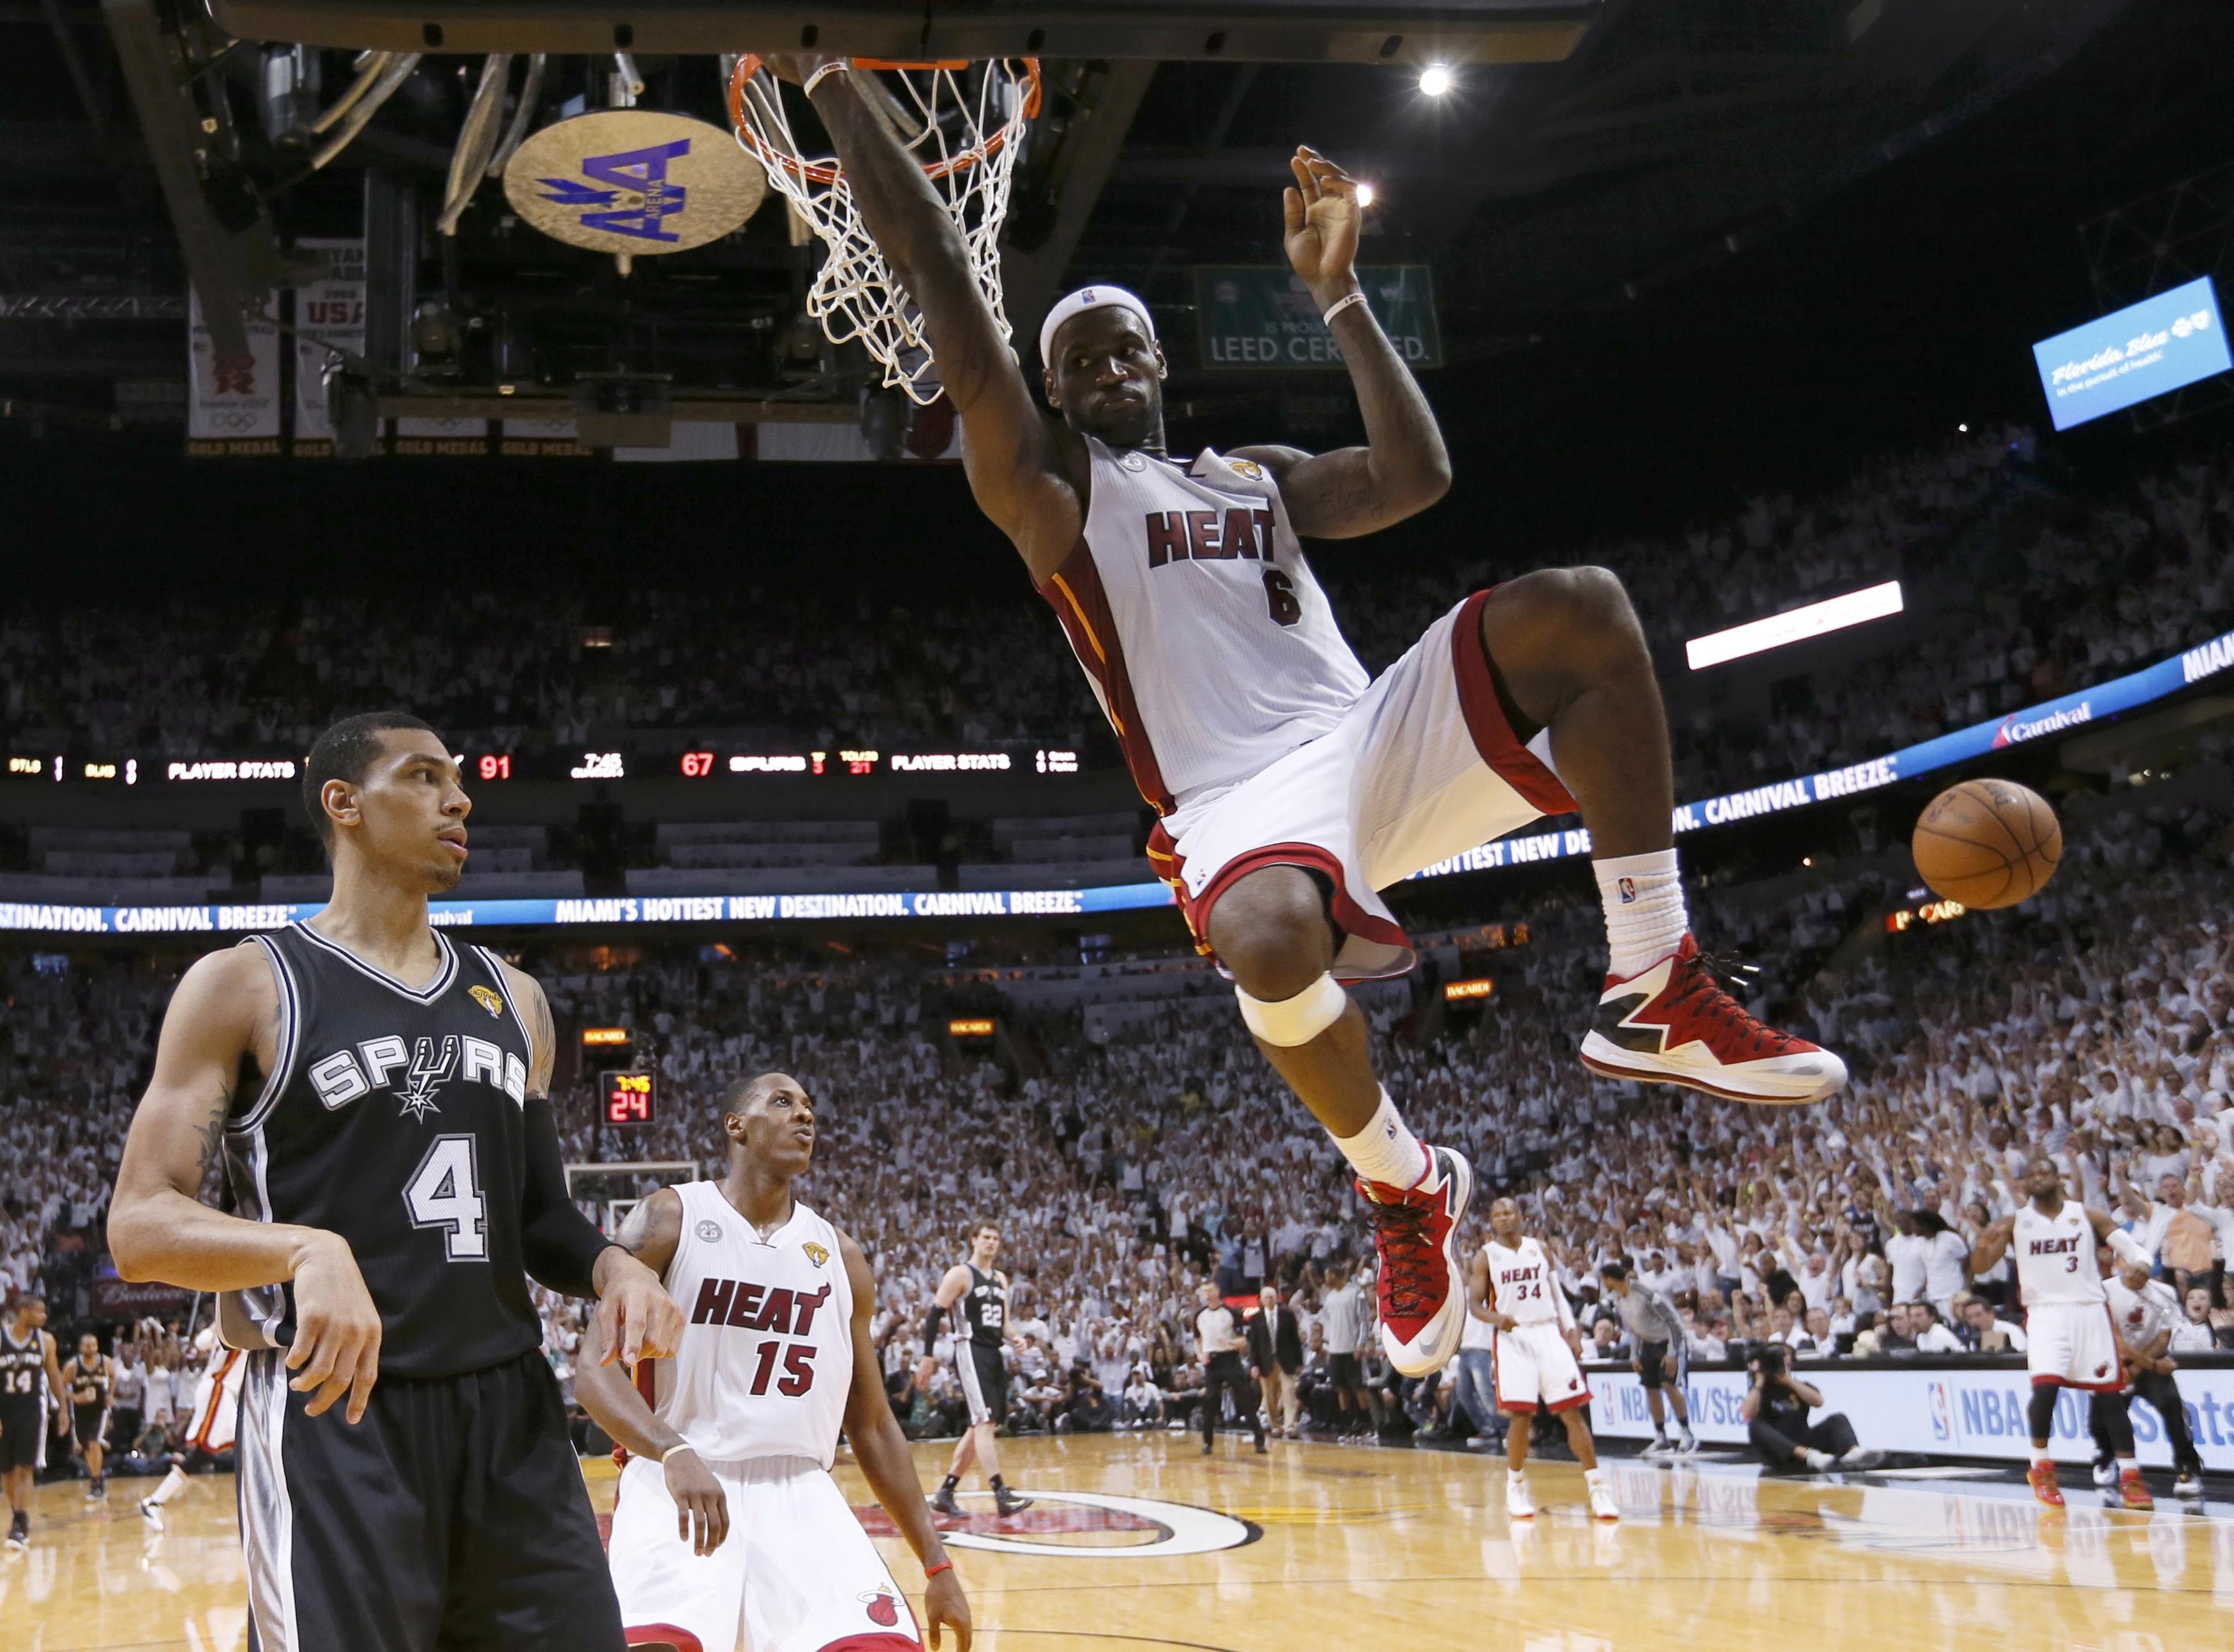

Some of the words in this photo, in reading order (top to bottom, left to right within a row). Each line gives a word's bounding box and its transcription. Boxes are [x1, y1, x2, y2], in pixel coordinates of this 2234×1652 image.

[644, 179, 664, 220] ARENA
[1211, 336, 1278, 361] LEED
[1287, 336, 1430, 361] CERED.
[2052, 347, 2124, 385] Florida
[2125, 331, 2168, 357] Blue
[1146, 498, 1275, 568] HEAT
[1261, 569, 1302, 627] 6
[2011, 701, 2092, 742] Carnival
[169, 762, 237, 779] PLAYER
[239, 762, 296, 779] STATS
[481, 756, 509, 779] 91
[682, 753, 714, 776] 67
[891, 755, 956, 770] PLAYER
[957, 754, 1010, 769] STATS
[1705, 779, 1811, 824] CARNIVAL
[1510, 834, 1559, 864] NEW
[115, 907, 213, 932] CARNIVAL
[428, 909, 473, 926] rnival
[555, 899, 638, 922] MIAMI'S
[643, 897, 725, 921] HOTTEST
[729, 896, 776, 919] NEW
[780, 894, 909, 918] DESTINATION.
[914, 892, 1006, 915] CARNIVAL
[308, 1035, 529, 1114] SPURS
[610, 1091, 648, 1122] 24
[401, 1133, 490, 1262] 4
[2029, 1233, 2082, 1256] HEAT
[1501, 1263, 1541, 1284] HEAT
[2065, 1255, 2078, 1273] 3
[1517, 1283, 1541, 1301] 34
[691, 1277, 832, 1336] HEAT
[981, 1303, 1003, 1328] 22
[5, 1370, 32, 1394] 14
[749, 1339, 818, 1399] 15
